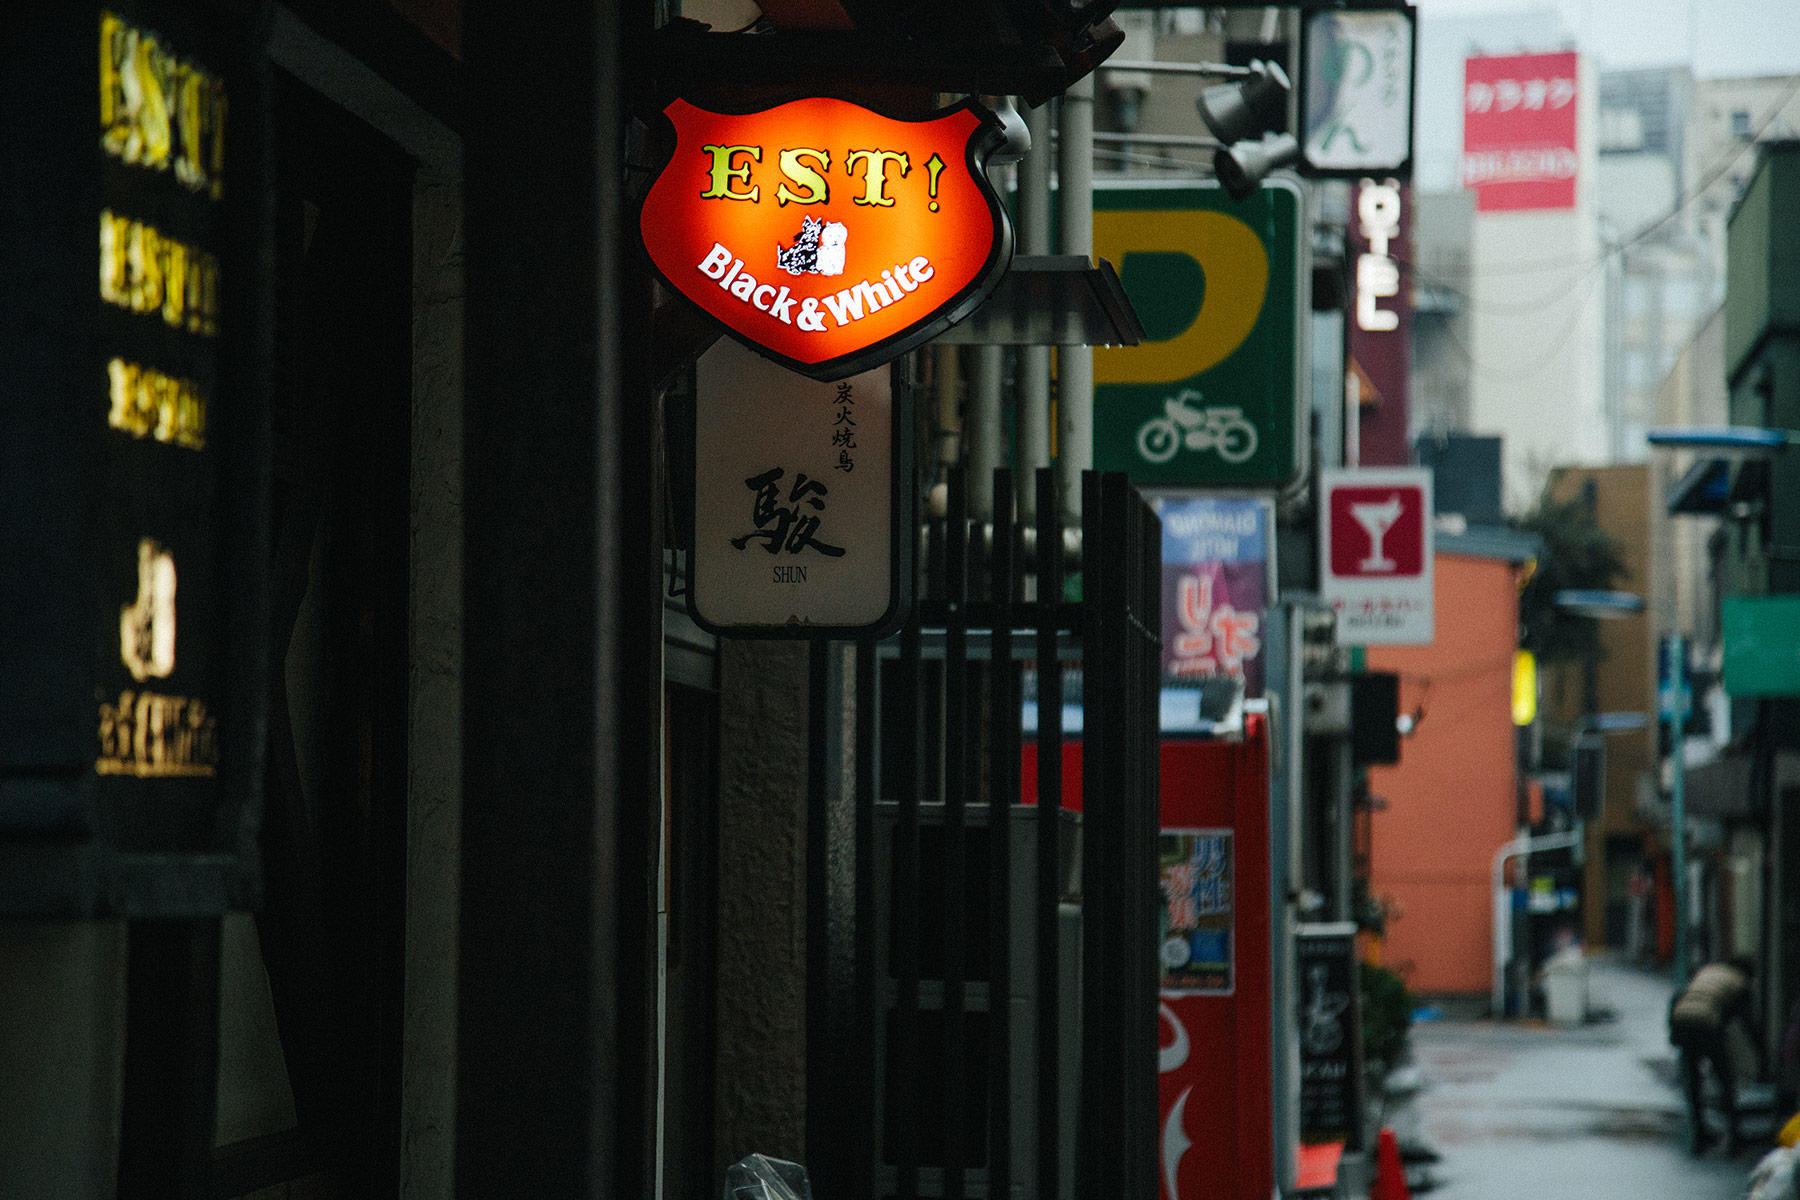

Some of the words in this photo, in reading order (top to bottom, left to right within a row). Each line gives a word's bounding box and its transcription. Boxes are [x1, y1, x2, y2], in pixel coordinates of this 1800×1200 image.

[699, 144, 947, 213] EST!
[832, 381, 857, 473] 炭火焼鳥
[727, 466, 846, 557] 駿
[772, 566, 808, 584] SHUN
